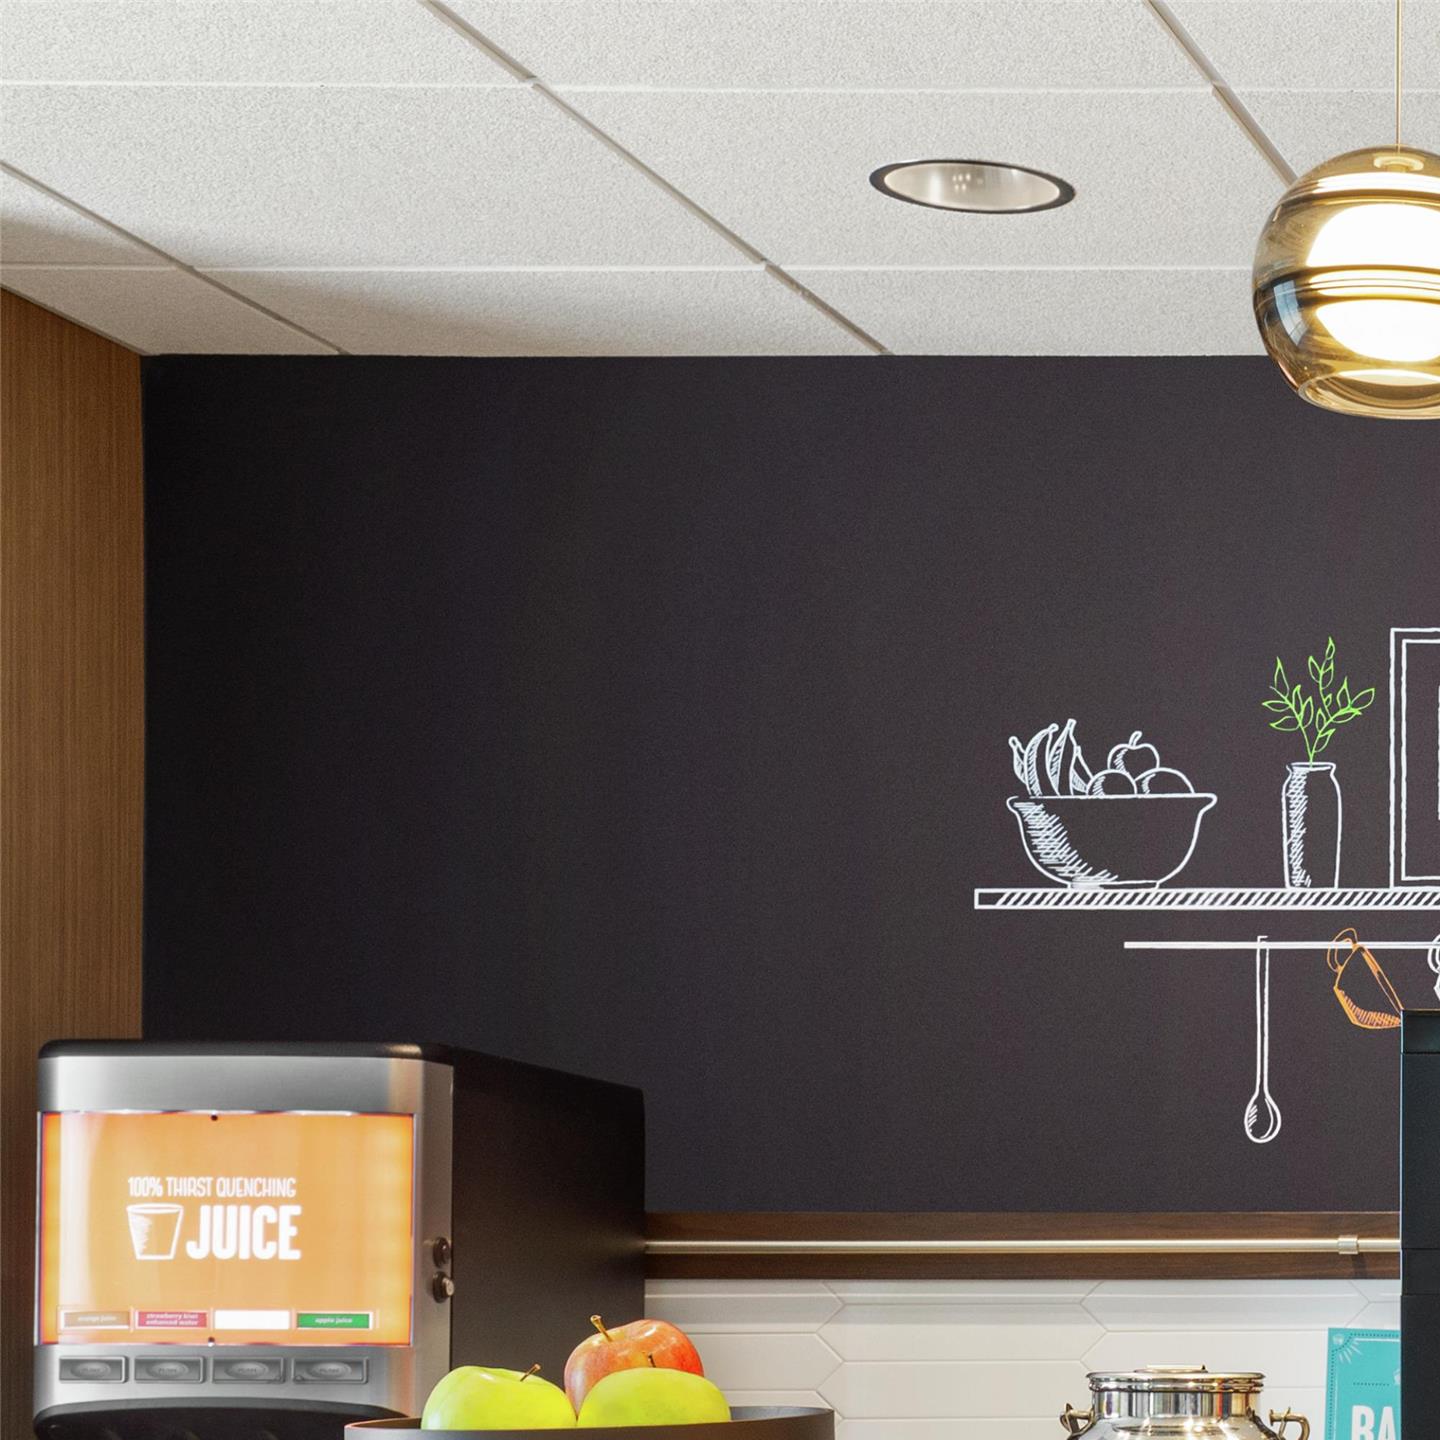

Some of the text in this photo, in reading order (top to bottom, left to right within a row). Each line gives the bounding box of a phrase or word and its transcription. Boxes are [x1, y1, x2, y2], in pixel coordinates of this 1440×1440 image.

[127, 1176, 297, 1198] 100% THIRST QUENCHING
[185, 1204, 302, 1260] JUICE
